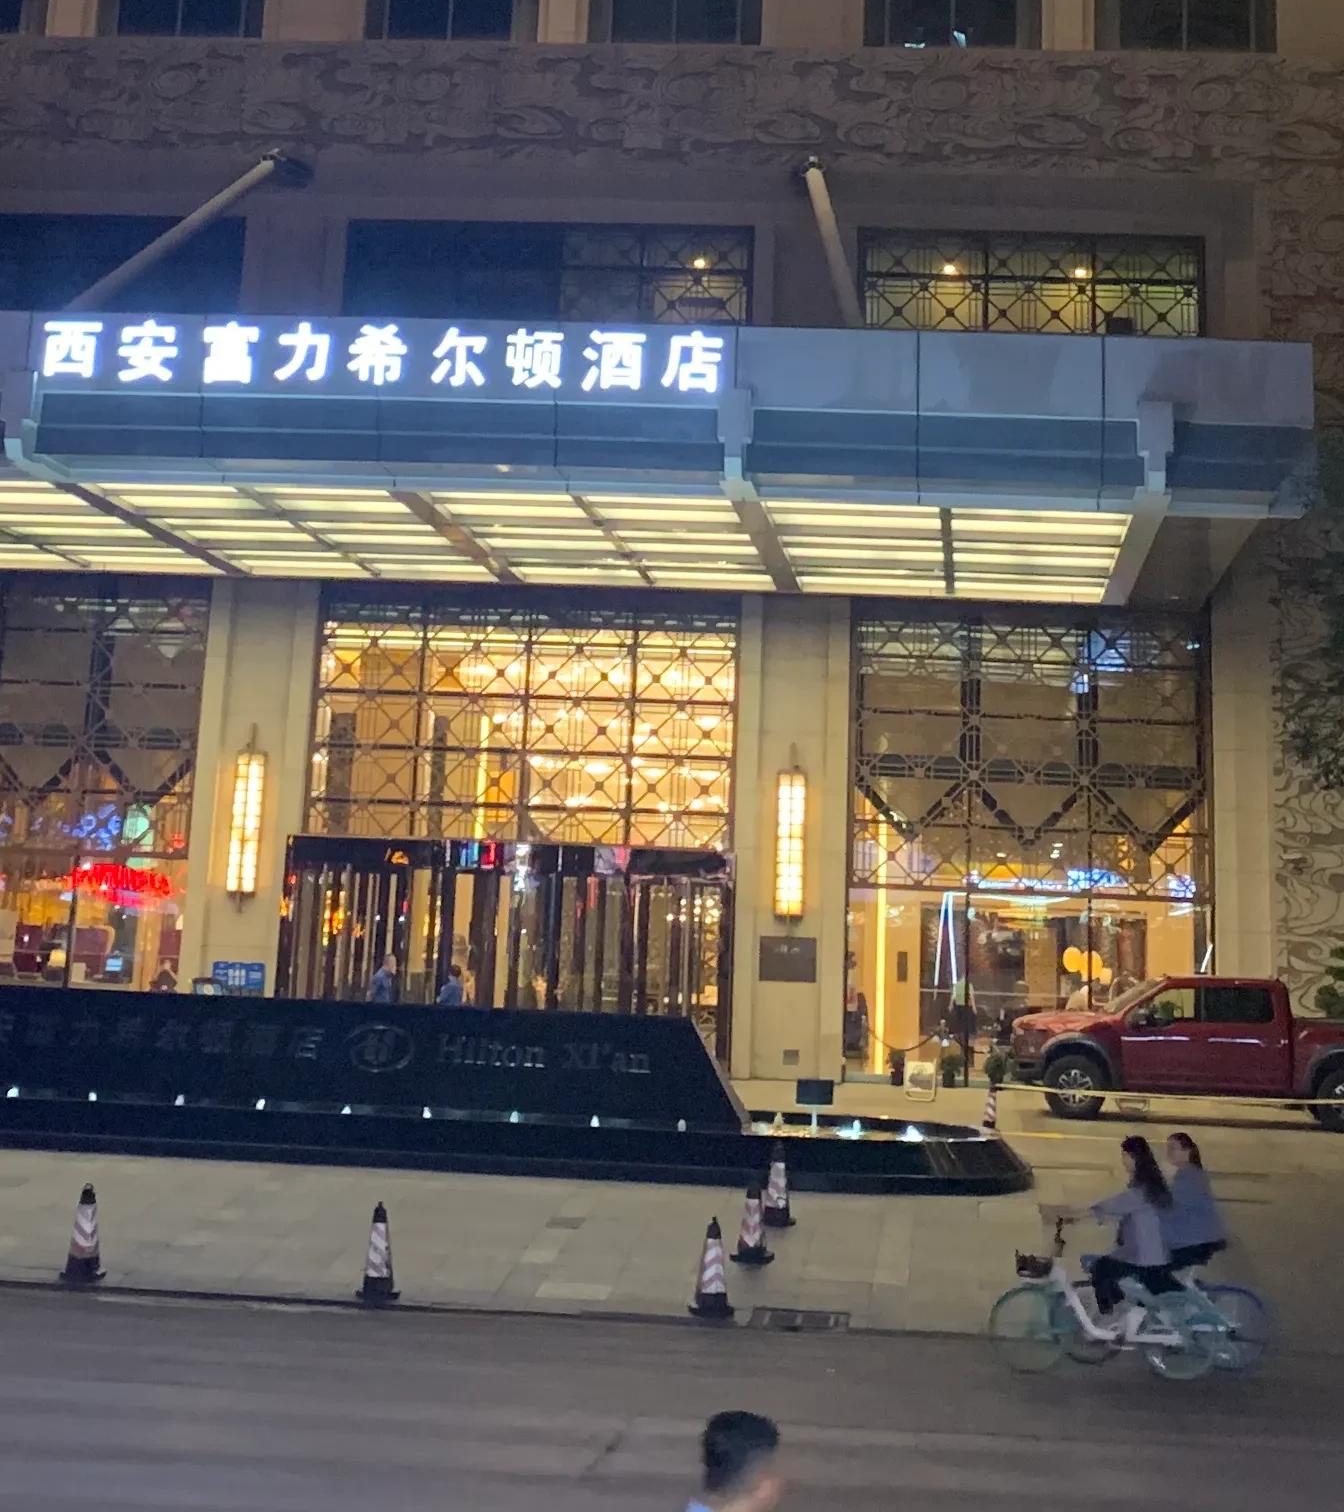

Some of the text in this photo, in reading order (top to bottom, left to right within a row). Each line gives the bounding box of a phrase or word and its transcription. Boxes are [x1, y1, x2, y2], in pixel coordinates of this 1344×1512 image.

[42, 319, 726, 394] 西安富力希尔顿酒店
[436, 1034, 546, 1069] Hilton
